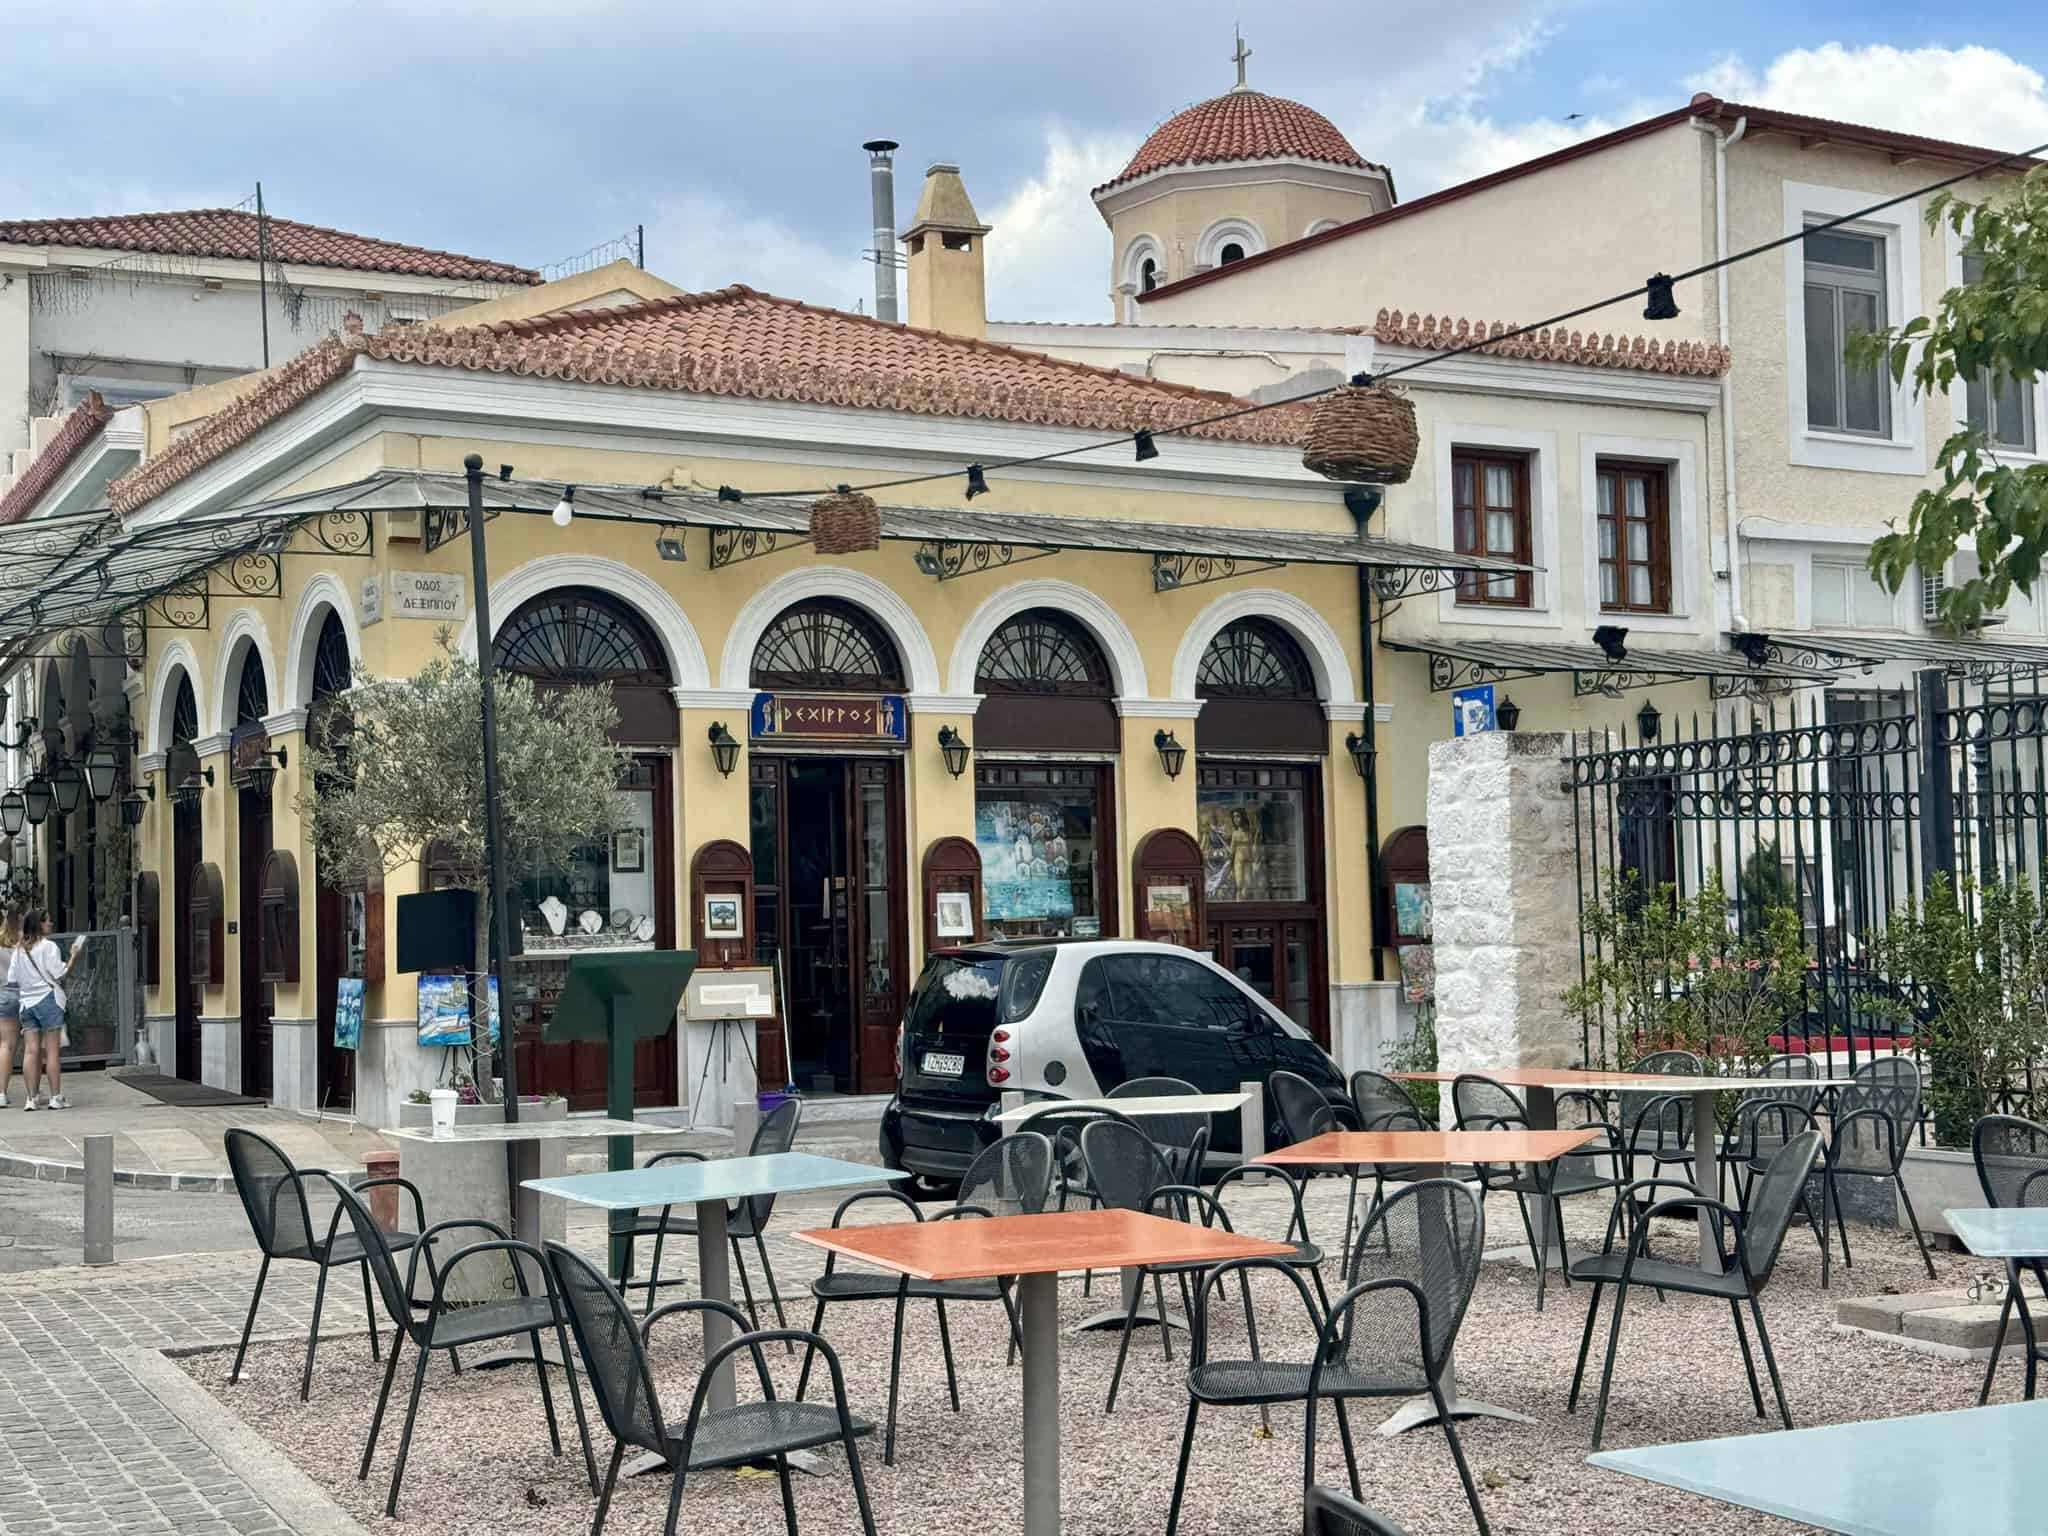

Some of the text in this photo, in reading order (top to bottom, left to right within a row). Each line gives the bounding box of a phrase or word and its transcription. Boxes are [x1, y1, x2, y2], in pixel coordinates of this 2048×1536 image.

[415, 579, 441, 592] ΟΔΟΣ
[403, 598, 457, 610] ΔΕΞΙΠΠΟΥ
[784, 706, 873, 724] DEXIPPOS
